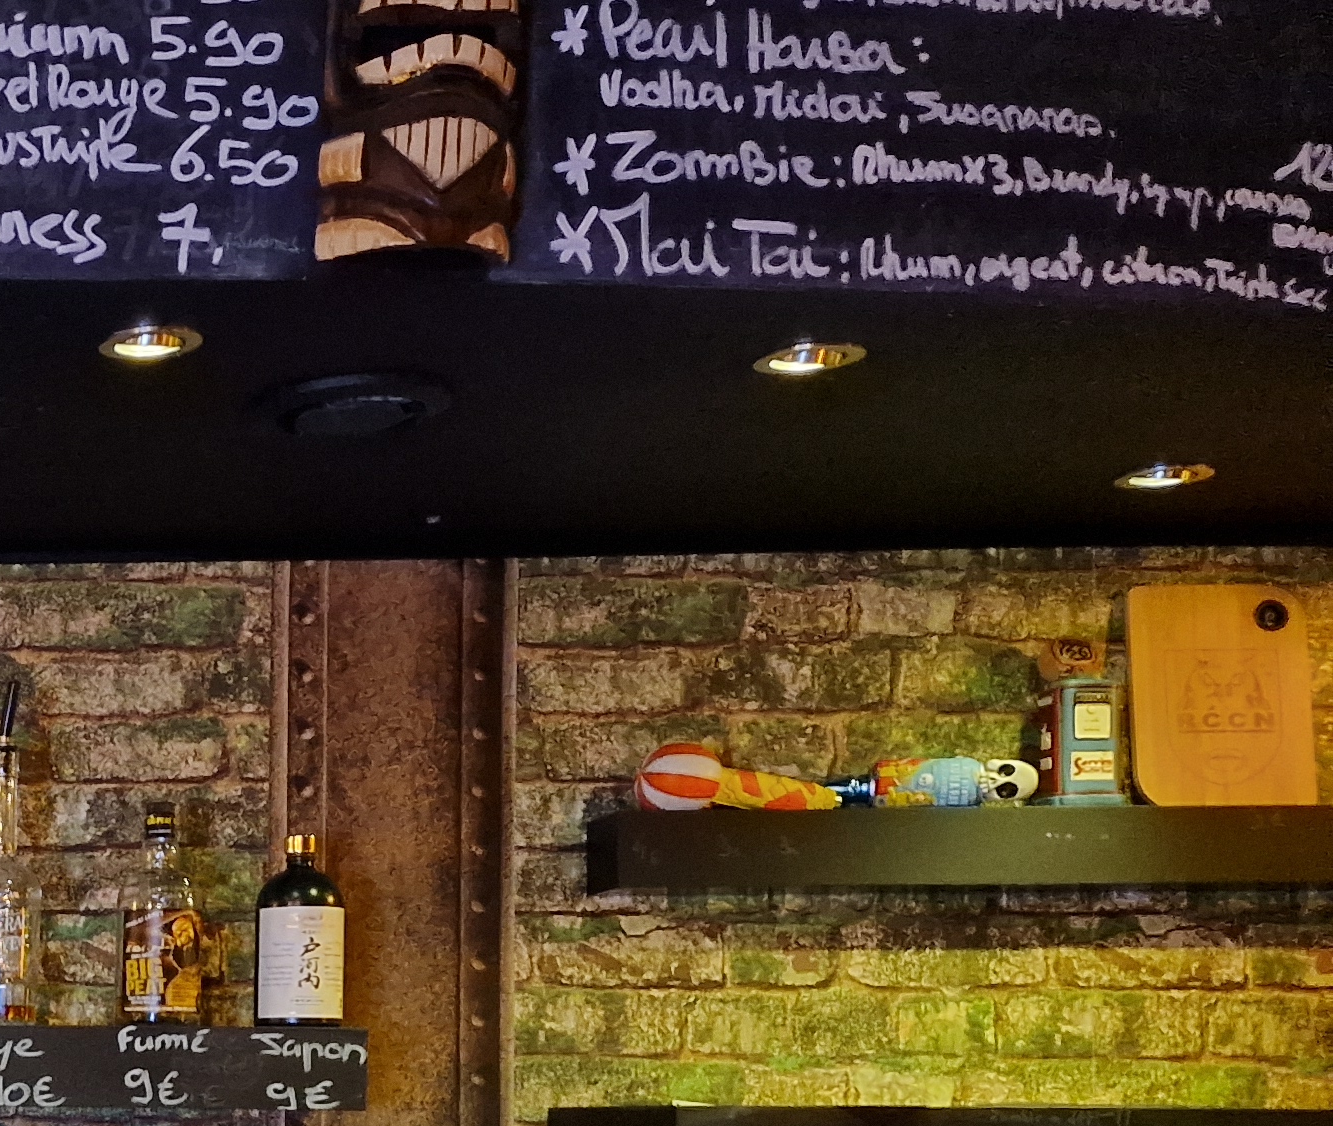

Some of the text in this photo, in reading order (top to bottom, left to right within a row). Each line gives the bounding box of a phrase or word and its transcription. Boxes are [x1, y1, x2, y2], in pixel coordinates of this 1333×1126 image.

[151, 16, 284, 67] 5.90
[600, 1, 727, 68] Pearl
[48, 63, 178, 135] Rouge
[186, 77, 319, 130] 5.90
[171, 125, 298, 187] 6.50
[600, 194, 729, 276] Mai
[125, 957, 164, 980] BIG
[125, 977, 167, 997] PEAT
[251, 1033, 367, 1072] Japon
[126, 1068, 189, 1105] 9€
[265, 1082, 341, 1111] 9€
